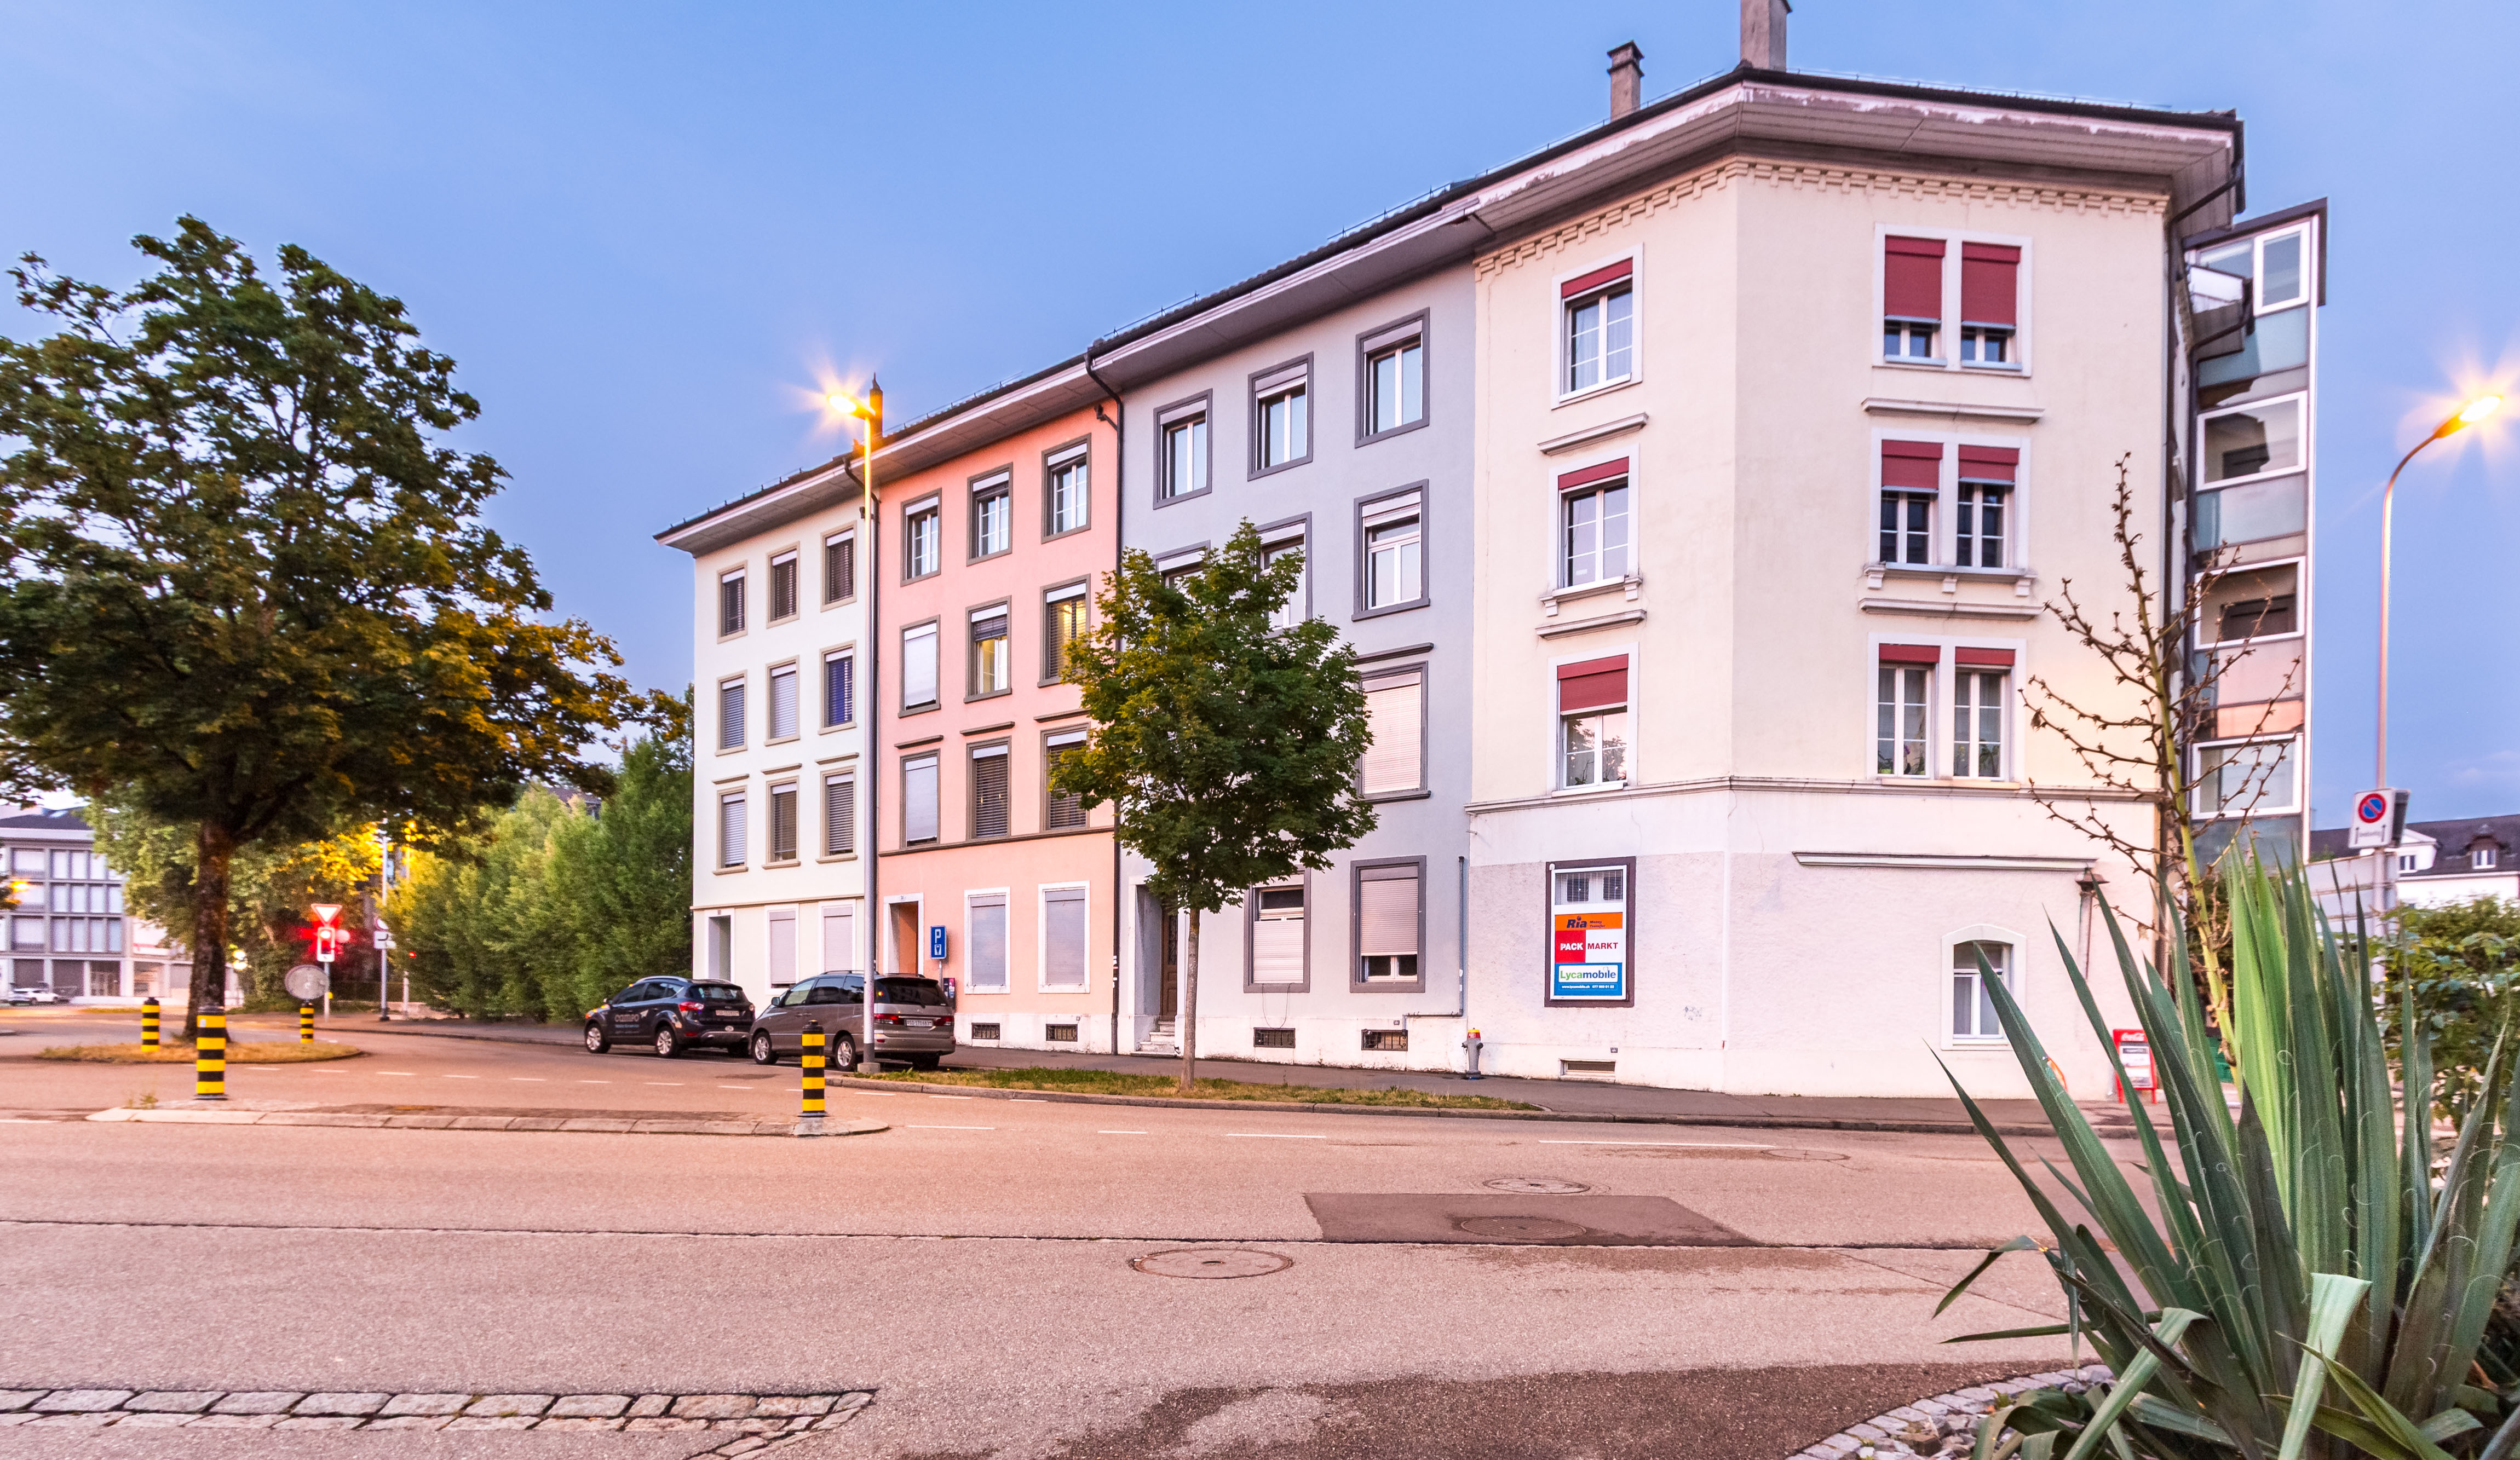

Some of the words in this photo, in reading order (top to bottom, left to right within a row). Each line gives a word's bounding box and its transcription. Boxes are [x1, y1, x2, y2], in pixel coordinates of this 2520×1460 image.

[1567, 915, 1587, 928] Ria
[935, 929, 941, 943] P
[1560, 970, 1616, 980] Lycamobile
